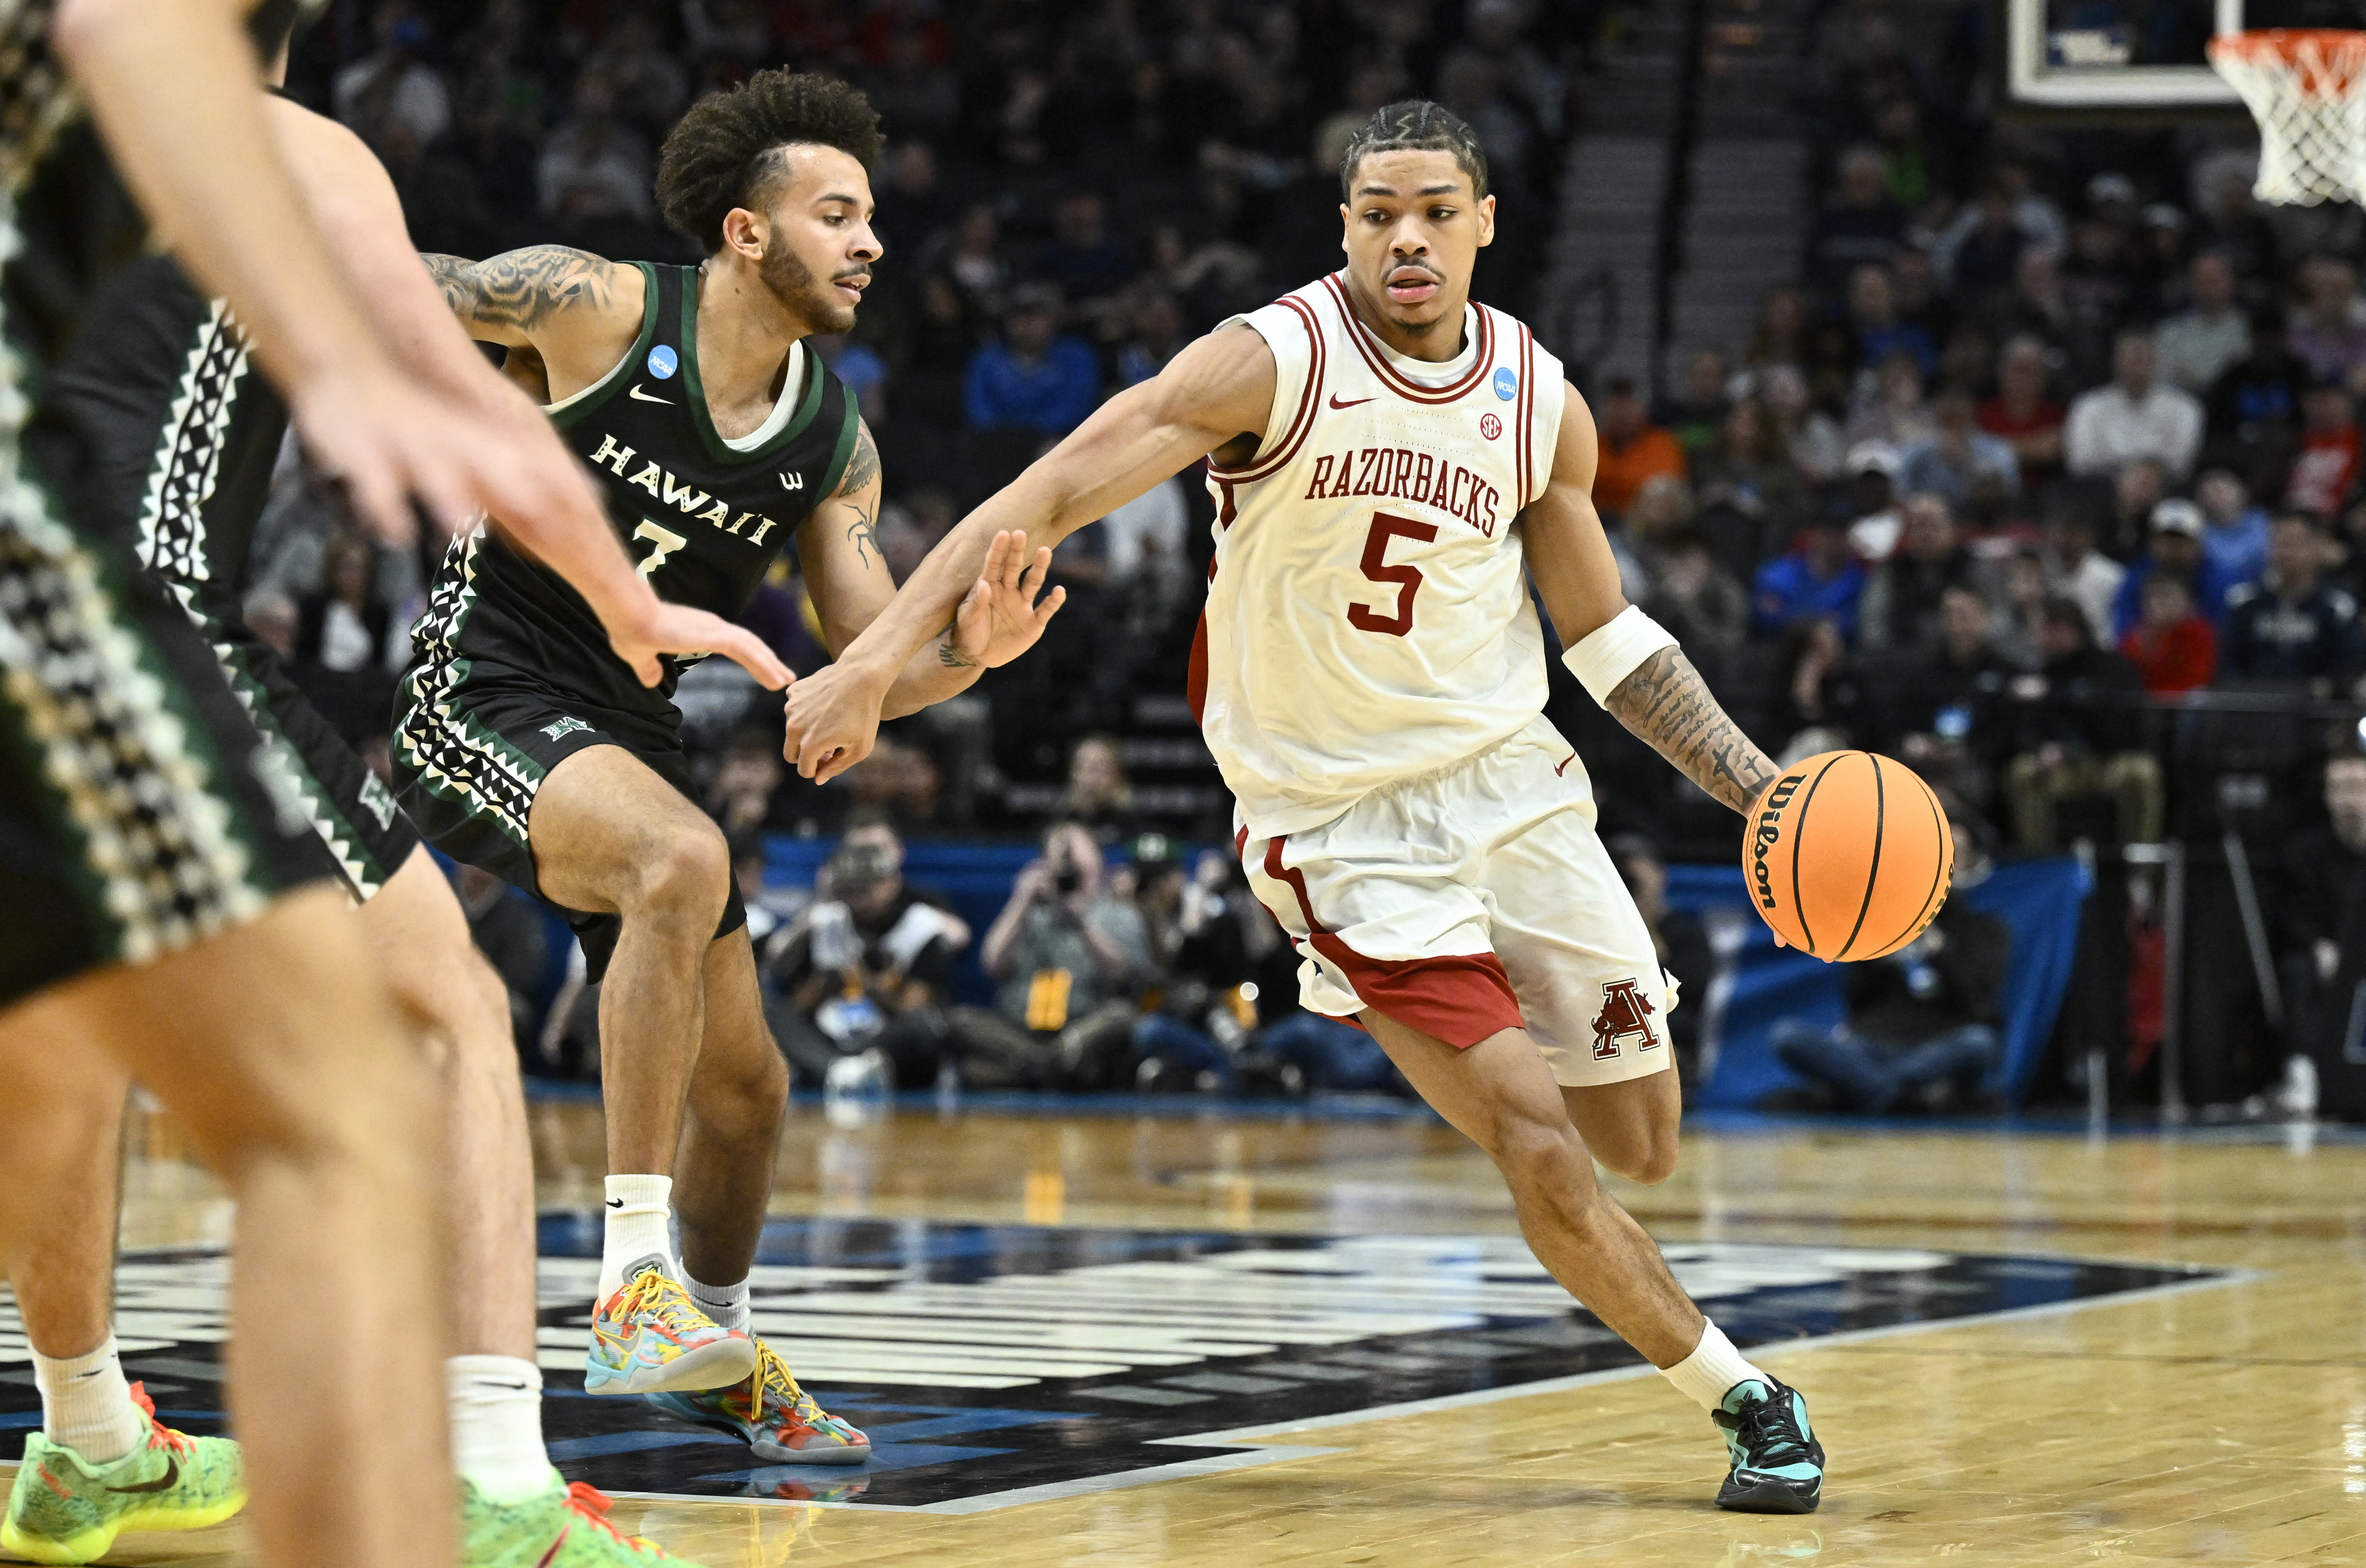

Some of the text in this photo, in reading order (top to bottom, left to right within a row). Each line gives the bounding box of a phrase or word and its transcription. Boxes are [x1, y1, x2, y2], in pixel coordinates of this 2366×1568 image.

[651, 355, 673, 376] NCAA
[1496, 381, 1515, 394] NCAA
[1482, 415, 1500, 438] SEC
[1305, 448, 1499, 538] RAZORBACKS
[632, 518, 687, 587] 7
[1346, 511, 1438, 637] 5
[1705, 707, 1718, 722] what
[1754, 774, 1809, 910] Wilson
